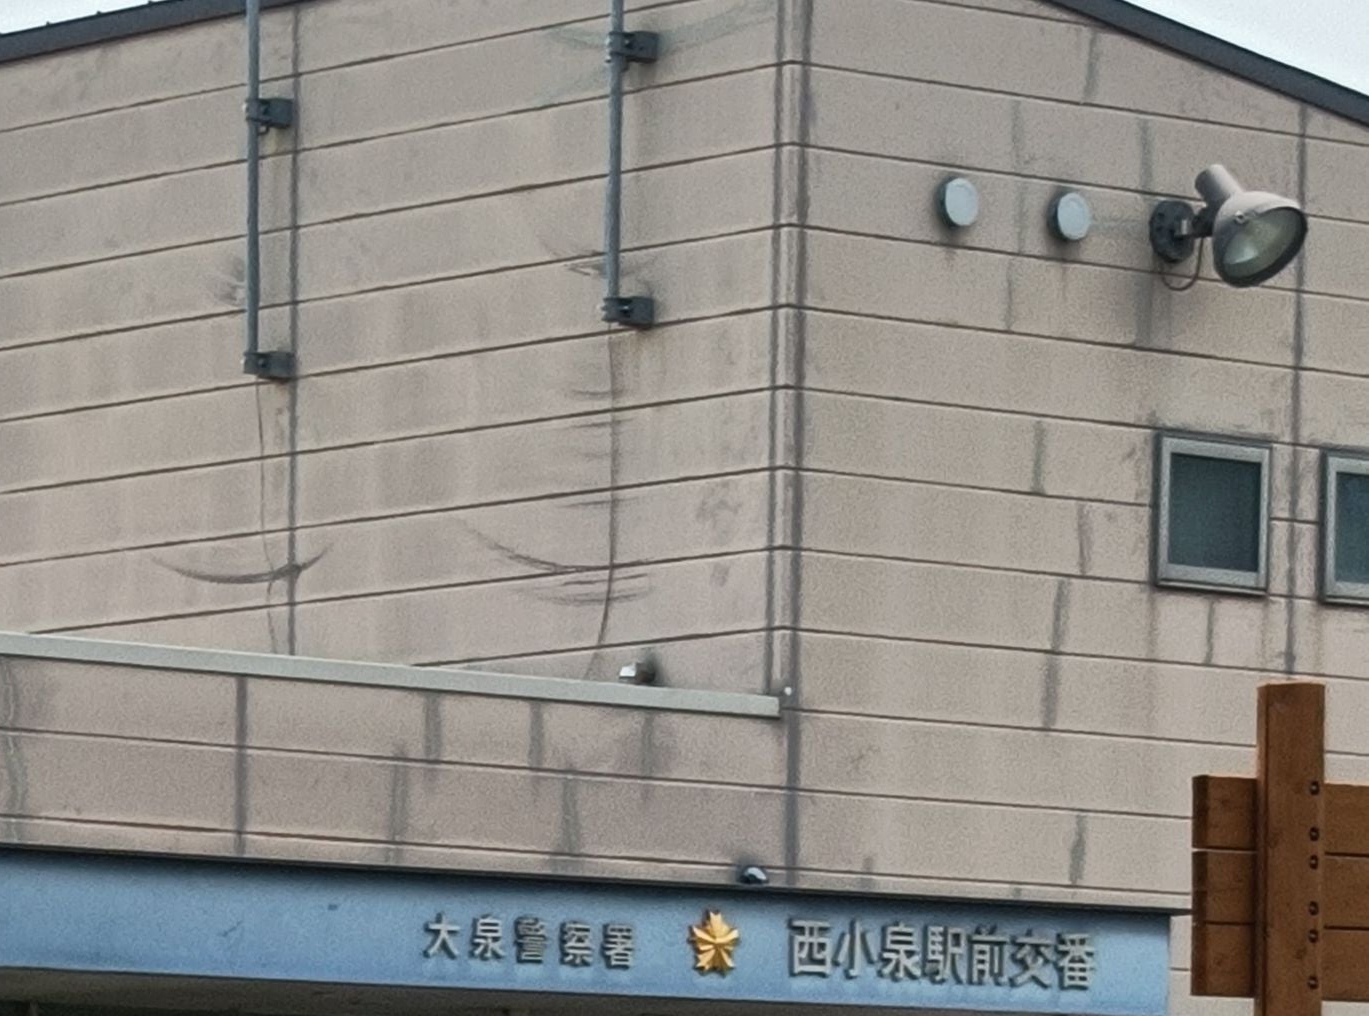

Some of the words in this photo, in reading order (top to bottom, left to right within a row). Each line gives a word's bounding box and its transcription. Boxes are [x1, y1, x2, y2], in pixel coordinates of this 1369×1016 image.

[424, 911, 634, 970] 大泉警察署
[788, 916, 1095, 991] 西小泉駅前交番
